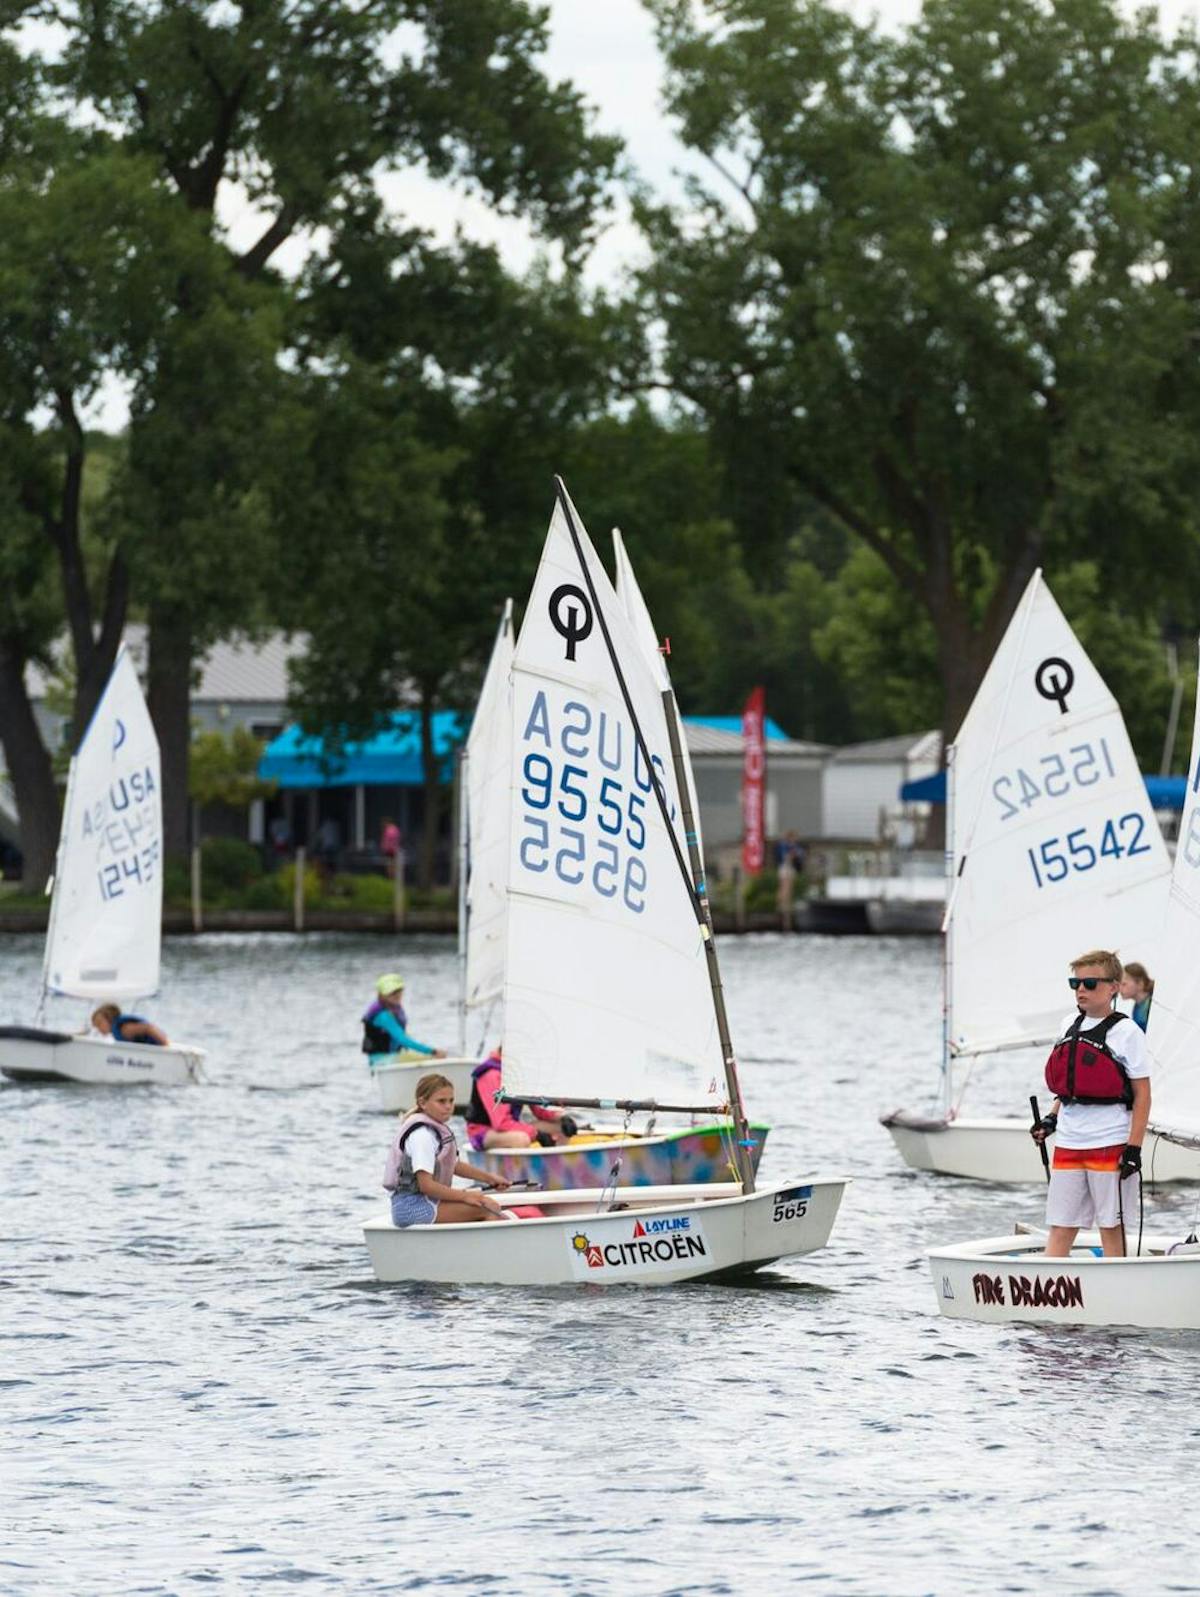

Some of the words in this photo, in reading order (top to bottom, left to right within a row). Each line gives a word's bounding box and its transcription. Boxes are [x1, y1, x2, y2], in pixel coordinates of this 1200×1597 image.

[110, 766, 155, 811] USA
[522, 753, 645, 850] 9555
[1027, 812, 1151, 888] 15542
[645, 1217, 690, 1233] LAYLINE
[773, 1200, 807, 1222] 565
[604, 1234, 706, 1266] CITROËN
[972, 1273, 1005, 1306] FIRE
[1008, 1274, 1084, 1309] DRAGON
